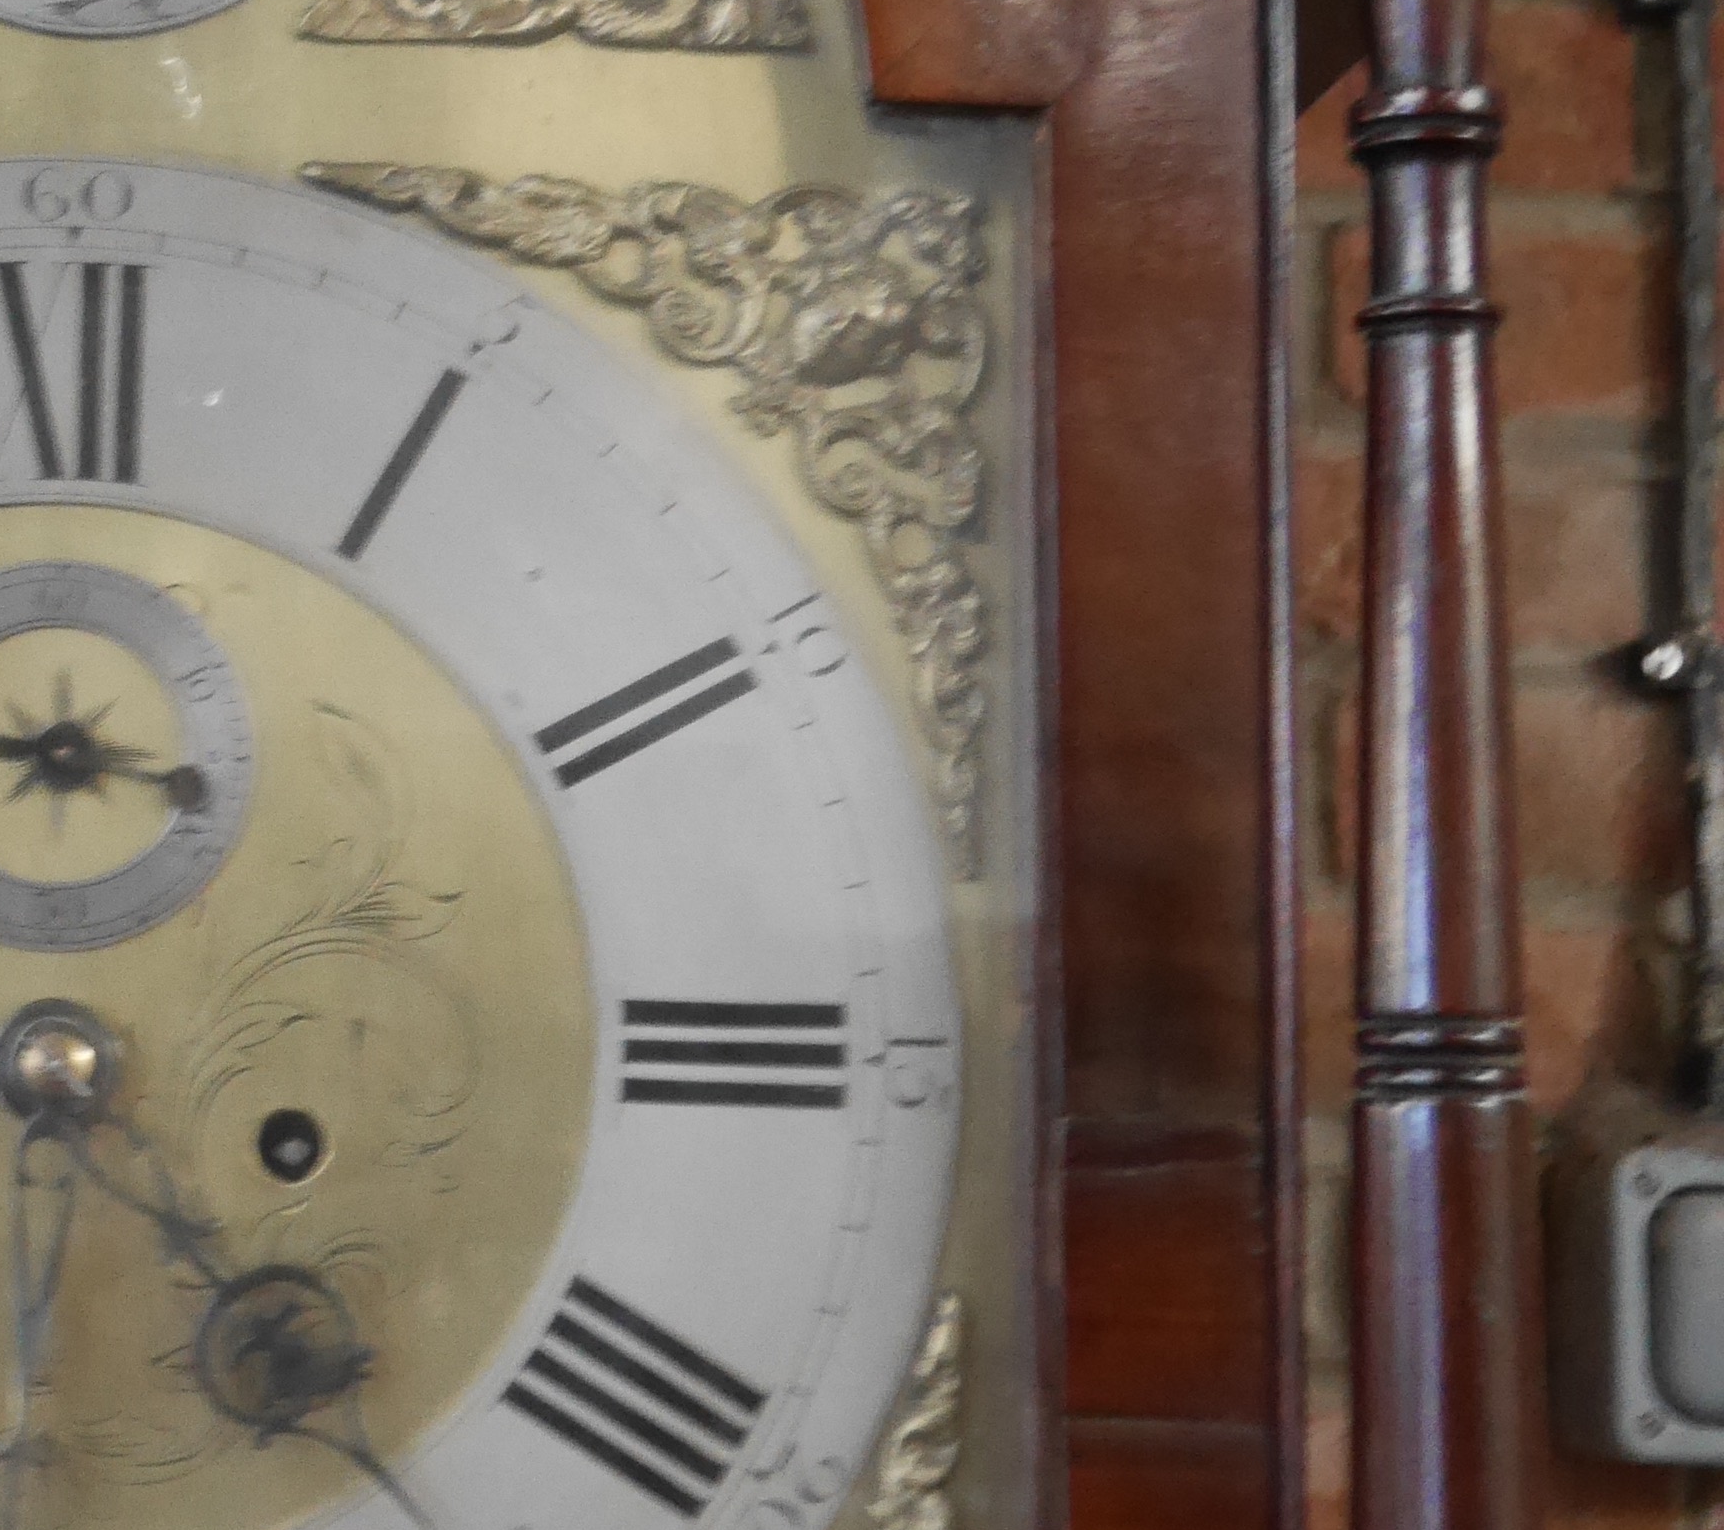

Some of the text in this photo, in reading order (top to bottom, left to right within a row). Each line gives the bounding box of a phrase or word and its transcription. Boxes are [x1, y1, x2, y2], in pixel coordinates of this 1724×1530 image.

[20, 166, 136, 223] 60
[326, 364, 470, 563] I
[764, 588, 853, 680] 10
[529, 632, 760, 791] II
[616, 996, 852, 1112] III
[882, 1032, 960, 1114] 15
[496, 1270, 772, 1521] IIII
